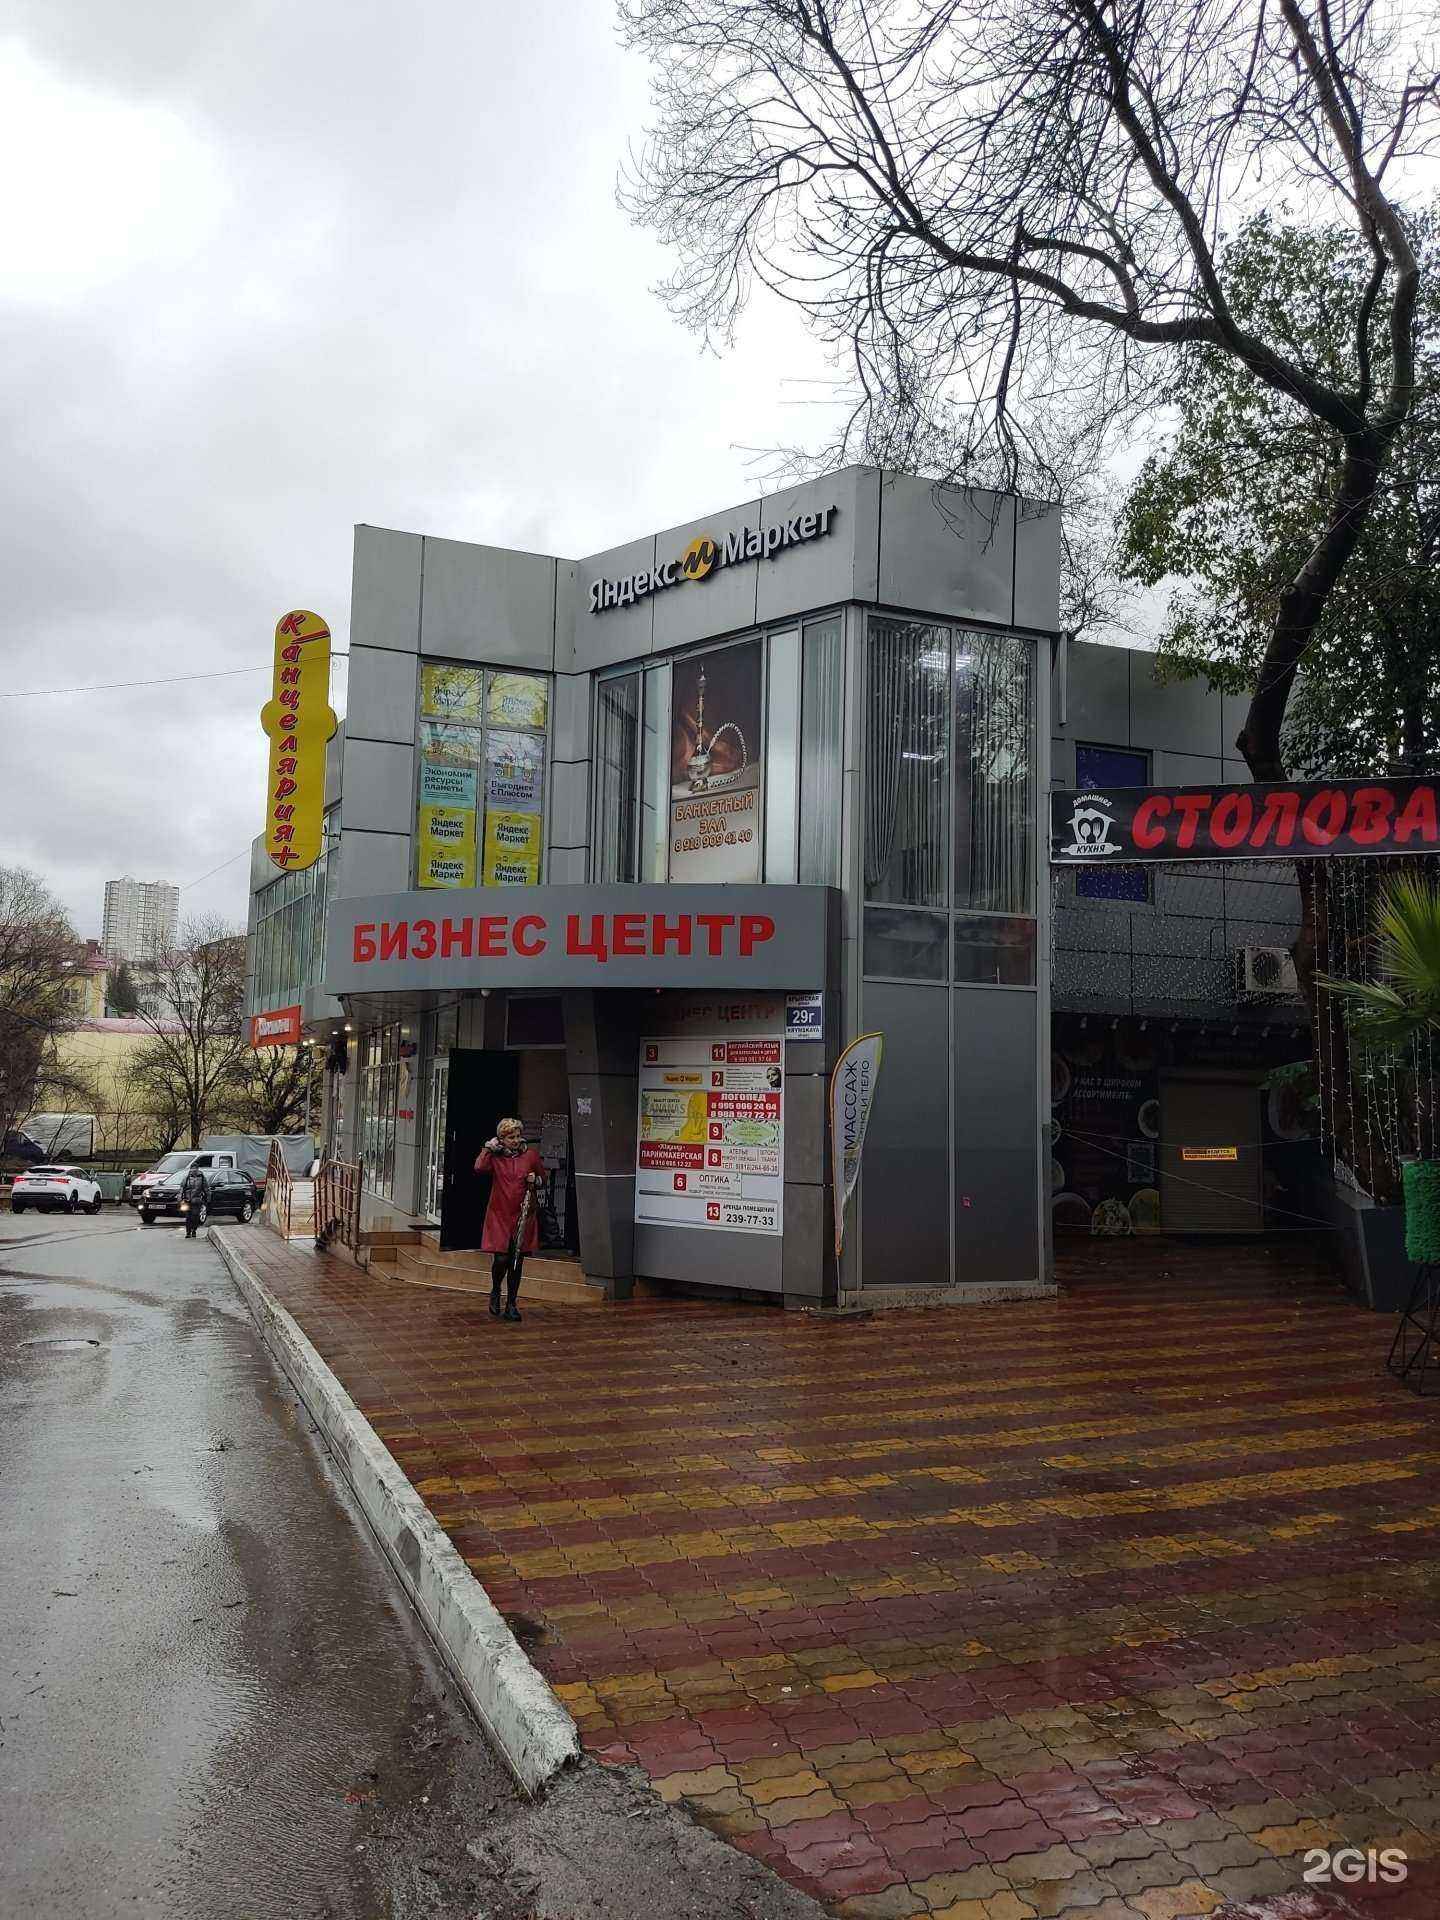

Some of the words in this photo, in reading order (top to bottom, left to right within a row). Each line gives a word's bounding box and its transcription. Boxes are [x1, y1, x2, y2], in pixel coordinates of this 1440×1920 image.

[588, 560, 678, 613] Яндекс
[720, 505, 836, 567] Маркет
[424, 767, 472, 779] Экономим
[424, 776, 463, 787] ресурсы
[424, 784, 464, 793] планеты
[675, 792, 753, 821] БАНКЕТНЫЙ
[431, 817, 464, 829] Яндекс
[497, 822, 529, 835] Яндекс
[699, 816, 727, 834] ЗАЛ
[430, 827, 464, 838] Маркет
[496, 831, 529, 844] Маркет
[1076, 844, 1106, 854] КУХНЯ
[431, 859, 464, 871] Яндекс
[495, 862, 527, 874] Яндекс
[430, 869, 464, 880] Маркет
[494, 872, 528, 884] Маркет
[352, 915, 547, 963] БИЗНЕС
[565, 914, 776, 963] ЦЕНТР
[792, 1009, 815, 1024] 29г
[648, 1047, 656, 1058] 3
[713, 1047, 724, 1058] 11
[714, 1072, 721, 1086] 2
[860, 1060, 870, 1097] ТЕЛО
[721, 1093, 767, 1102] ЛОГОПЕД
[844, 1060, 858, 1150] МАССАЖ
[712, 1126, 720, 1137] 9
[641, 1150, 703, 1160] ПАРИКМАХЕРСКАЯ
[711, 1152, 719, 1163] 8
[676, 1177, 684, 1187] 6
[699, 1174, 730, 1184] ОПТИКА
[708, 1206, 720, 1217] 13
[726, 1213, 774, 1226] 239-77-33
